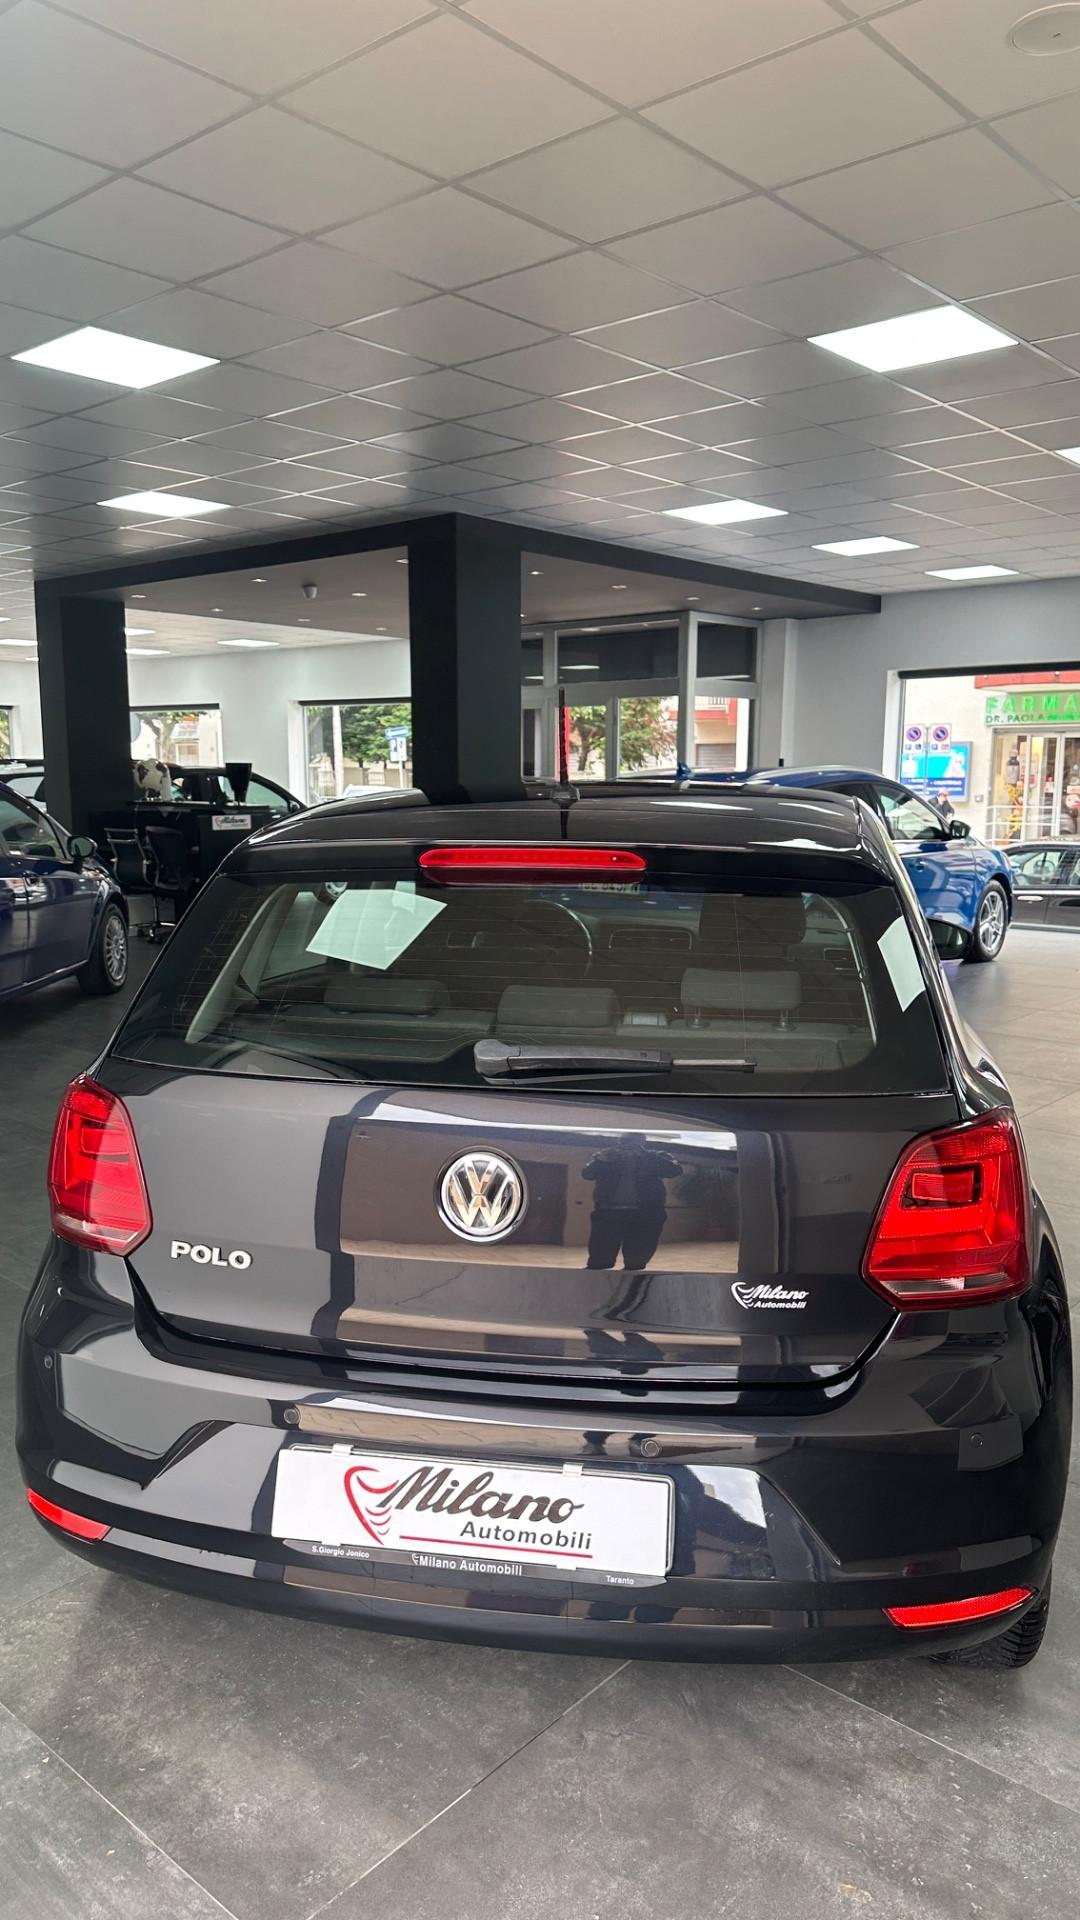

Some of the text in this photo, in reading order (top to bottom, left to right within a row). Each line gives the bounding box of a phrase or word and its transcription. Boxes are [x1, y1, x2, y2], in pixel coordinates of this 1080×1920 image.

[170, 1240, 253, 1270] POLO
[746, 1284, 809, 1300] Milano
[753, 1301, 807, 1309] Automobili
[377, 1466, 584, 1524] Milano
[459, 1521, 593, 1550] Automobili
[418, 1555, 523, 1576] Milano Automobili
[606, 1575, 635, 1585] Taranto
